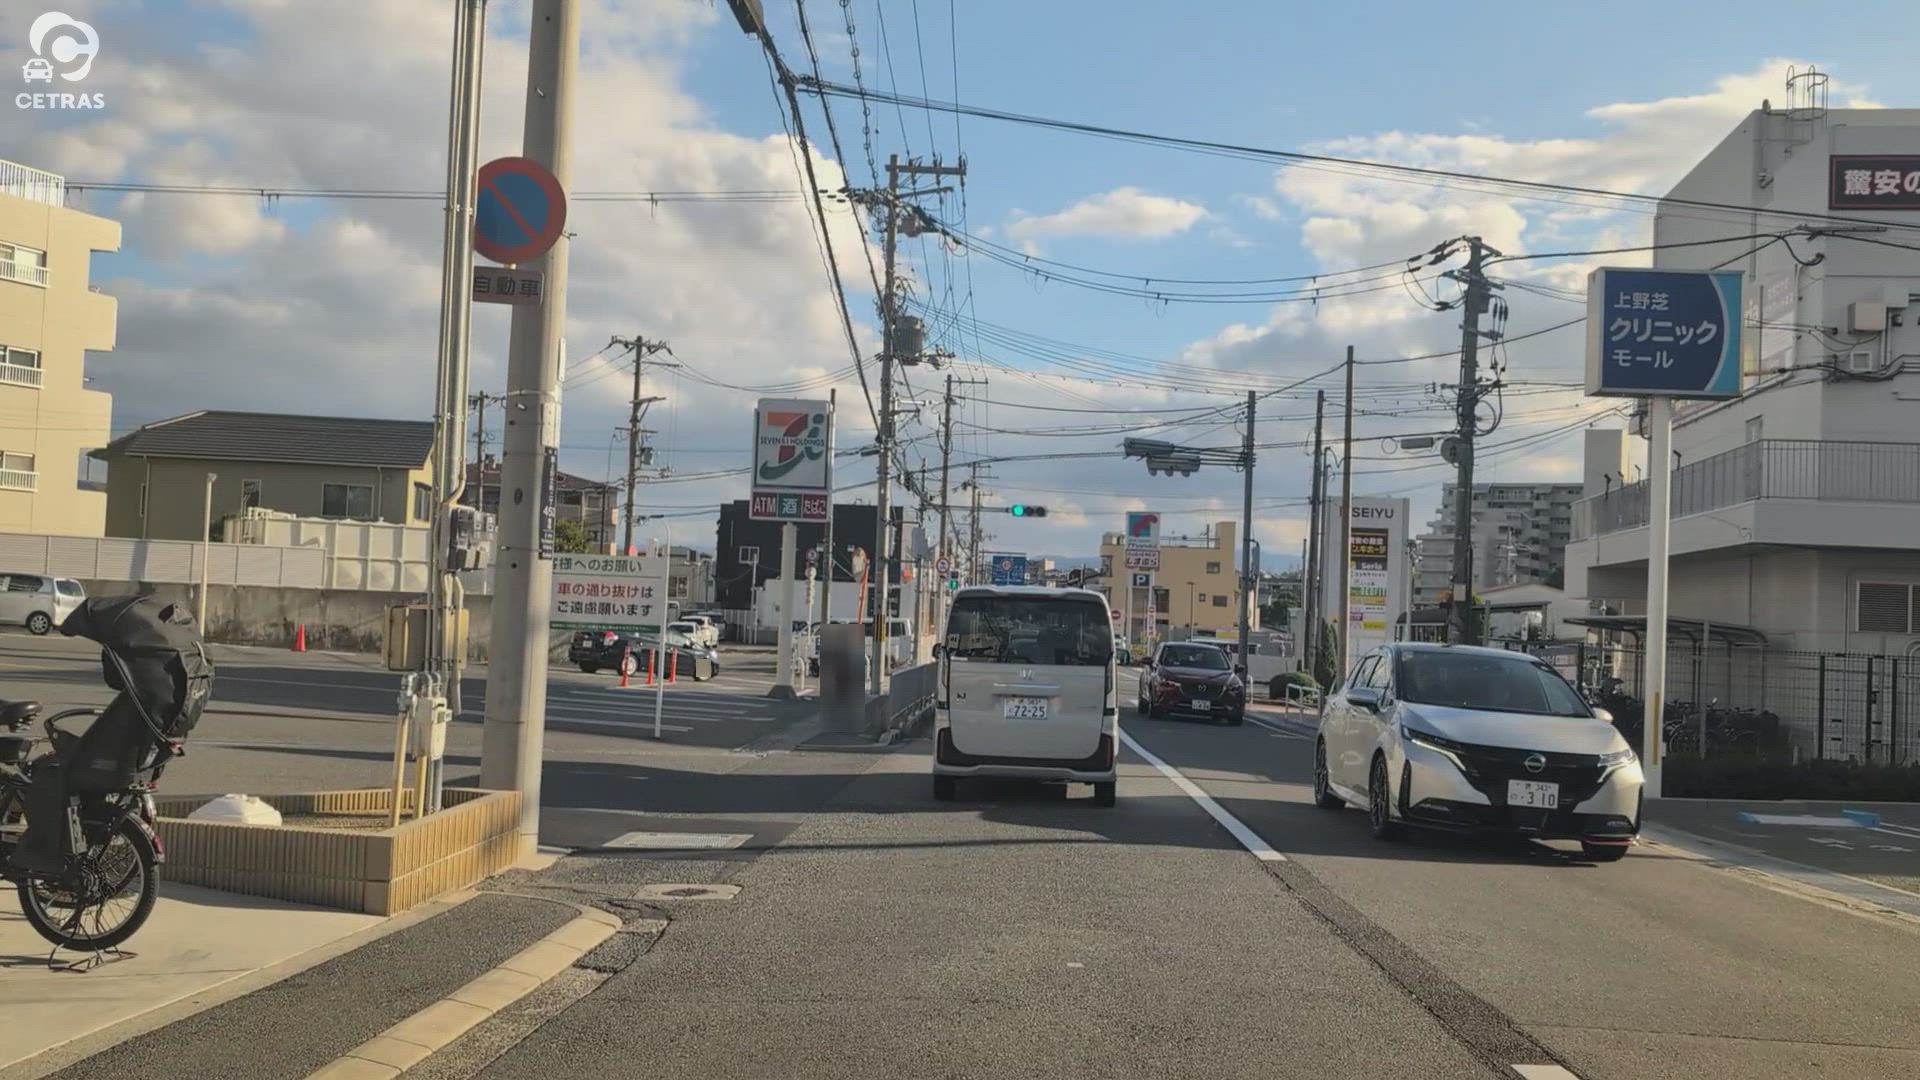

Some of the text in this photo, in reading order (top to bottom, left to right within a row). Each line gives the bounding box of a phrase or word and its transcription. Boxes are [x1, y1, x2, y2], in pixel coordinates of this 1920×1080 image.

[474, 275, 540, 297] 自動車
[1613, 291, 1670, 311] 上野芝
[1609, 316, 1718, 346] クリニック
[1612, 349, 1674, 369] モール
[753, 496, 777, 514] ATM
[782, 498, 798, 515] 酒
[804, 499, 827, 515] たばこ
[1352, 506, 1394, 519] SEIYU
[1136, 574, 1147, 587] P
[558, 582, 654, 599] 車の通り抜けは
[558, 600, 653, 617] ご遠慮願います
[1014, 705, 1046, 718] 72-25
